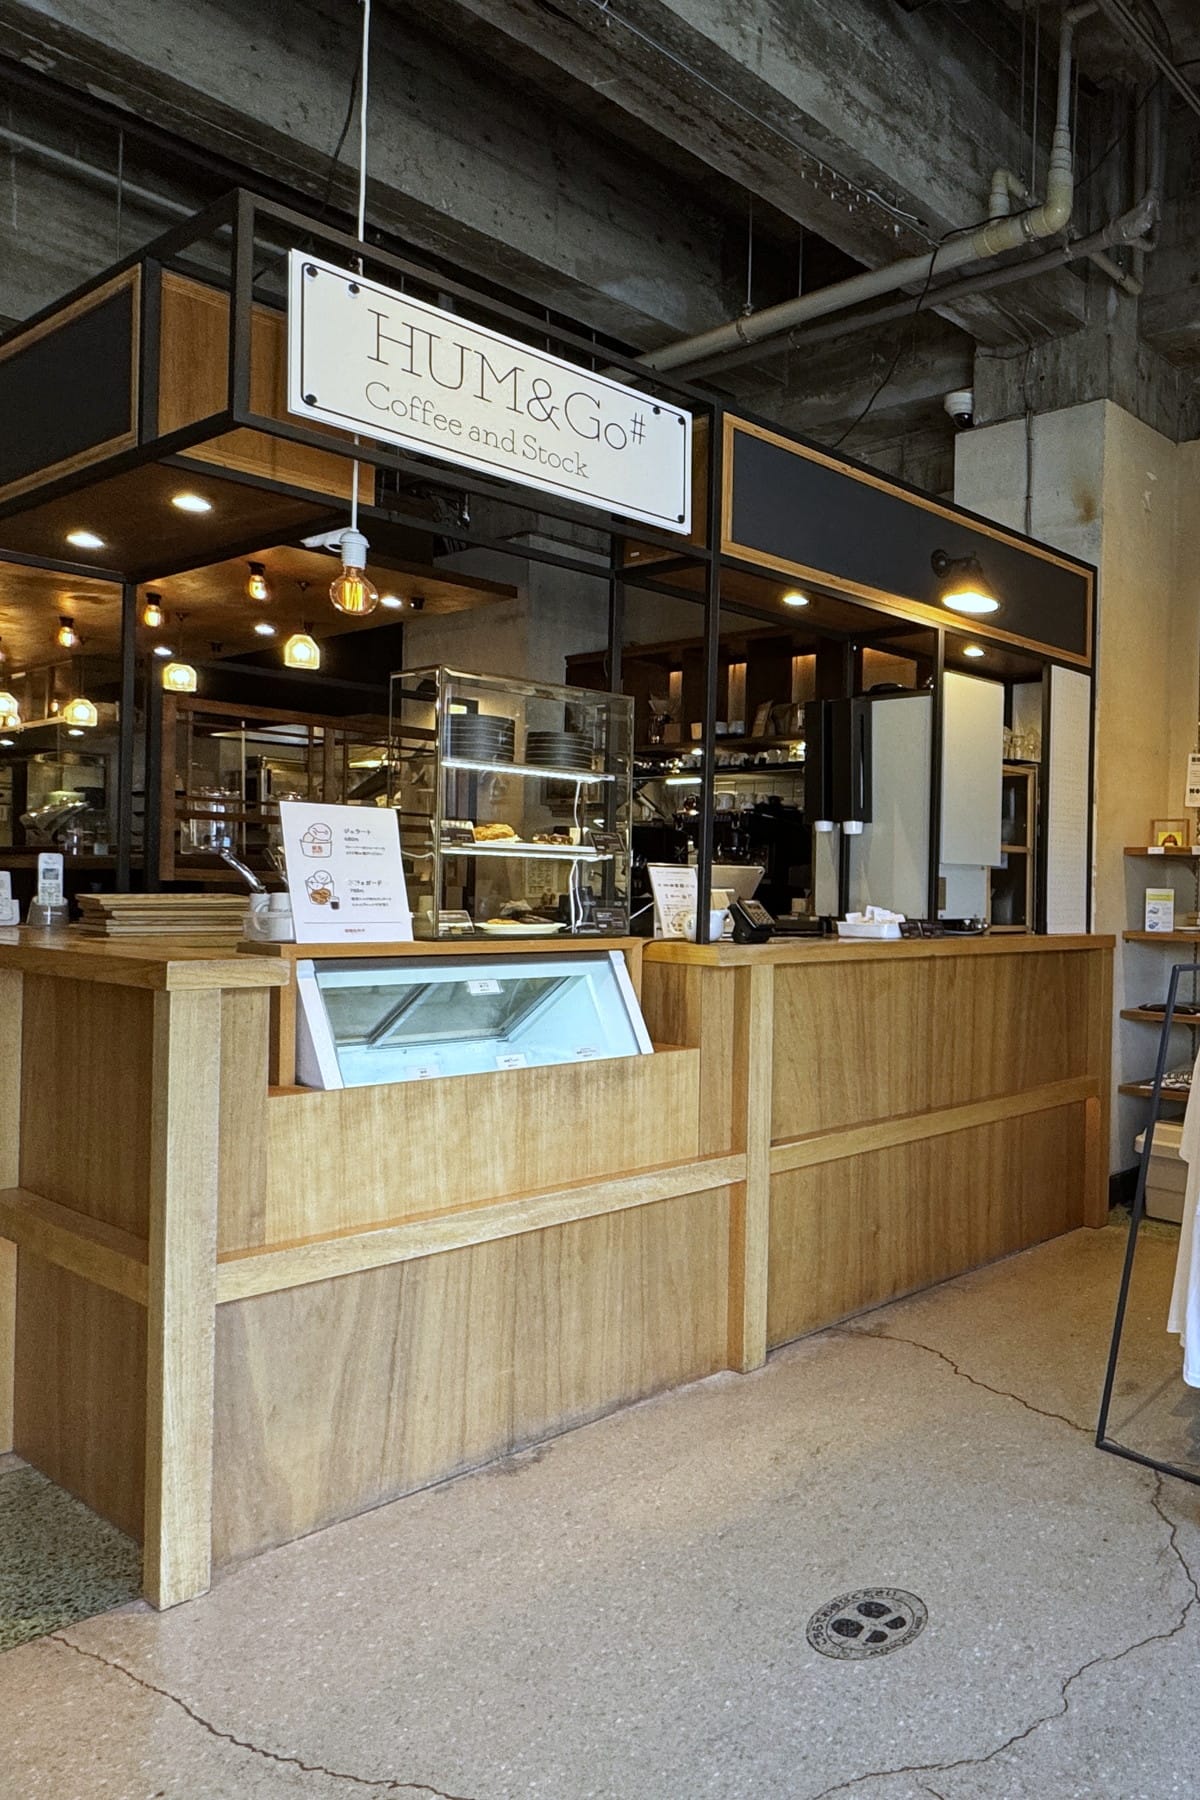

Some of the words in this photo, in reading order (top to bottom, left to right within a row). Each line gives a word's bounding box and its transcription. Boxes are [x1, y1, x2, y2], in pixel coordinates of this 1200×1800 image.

[365, 381, 463, 436] Coffee
[468, 429, 518, 456] and
[522, 434, 591, 479] Stock
[367, 308, 647, 450] HUM&Go#
